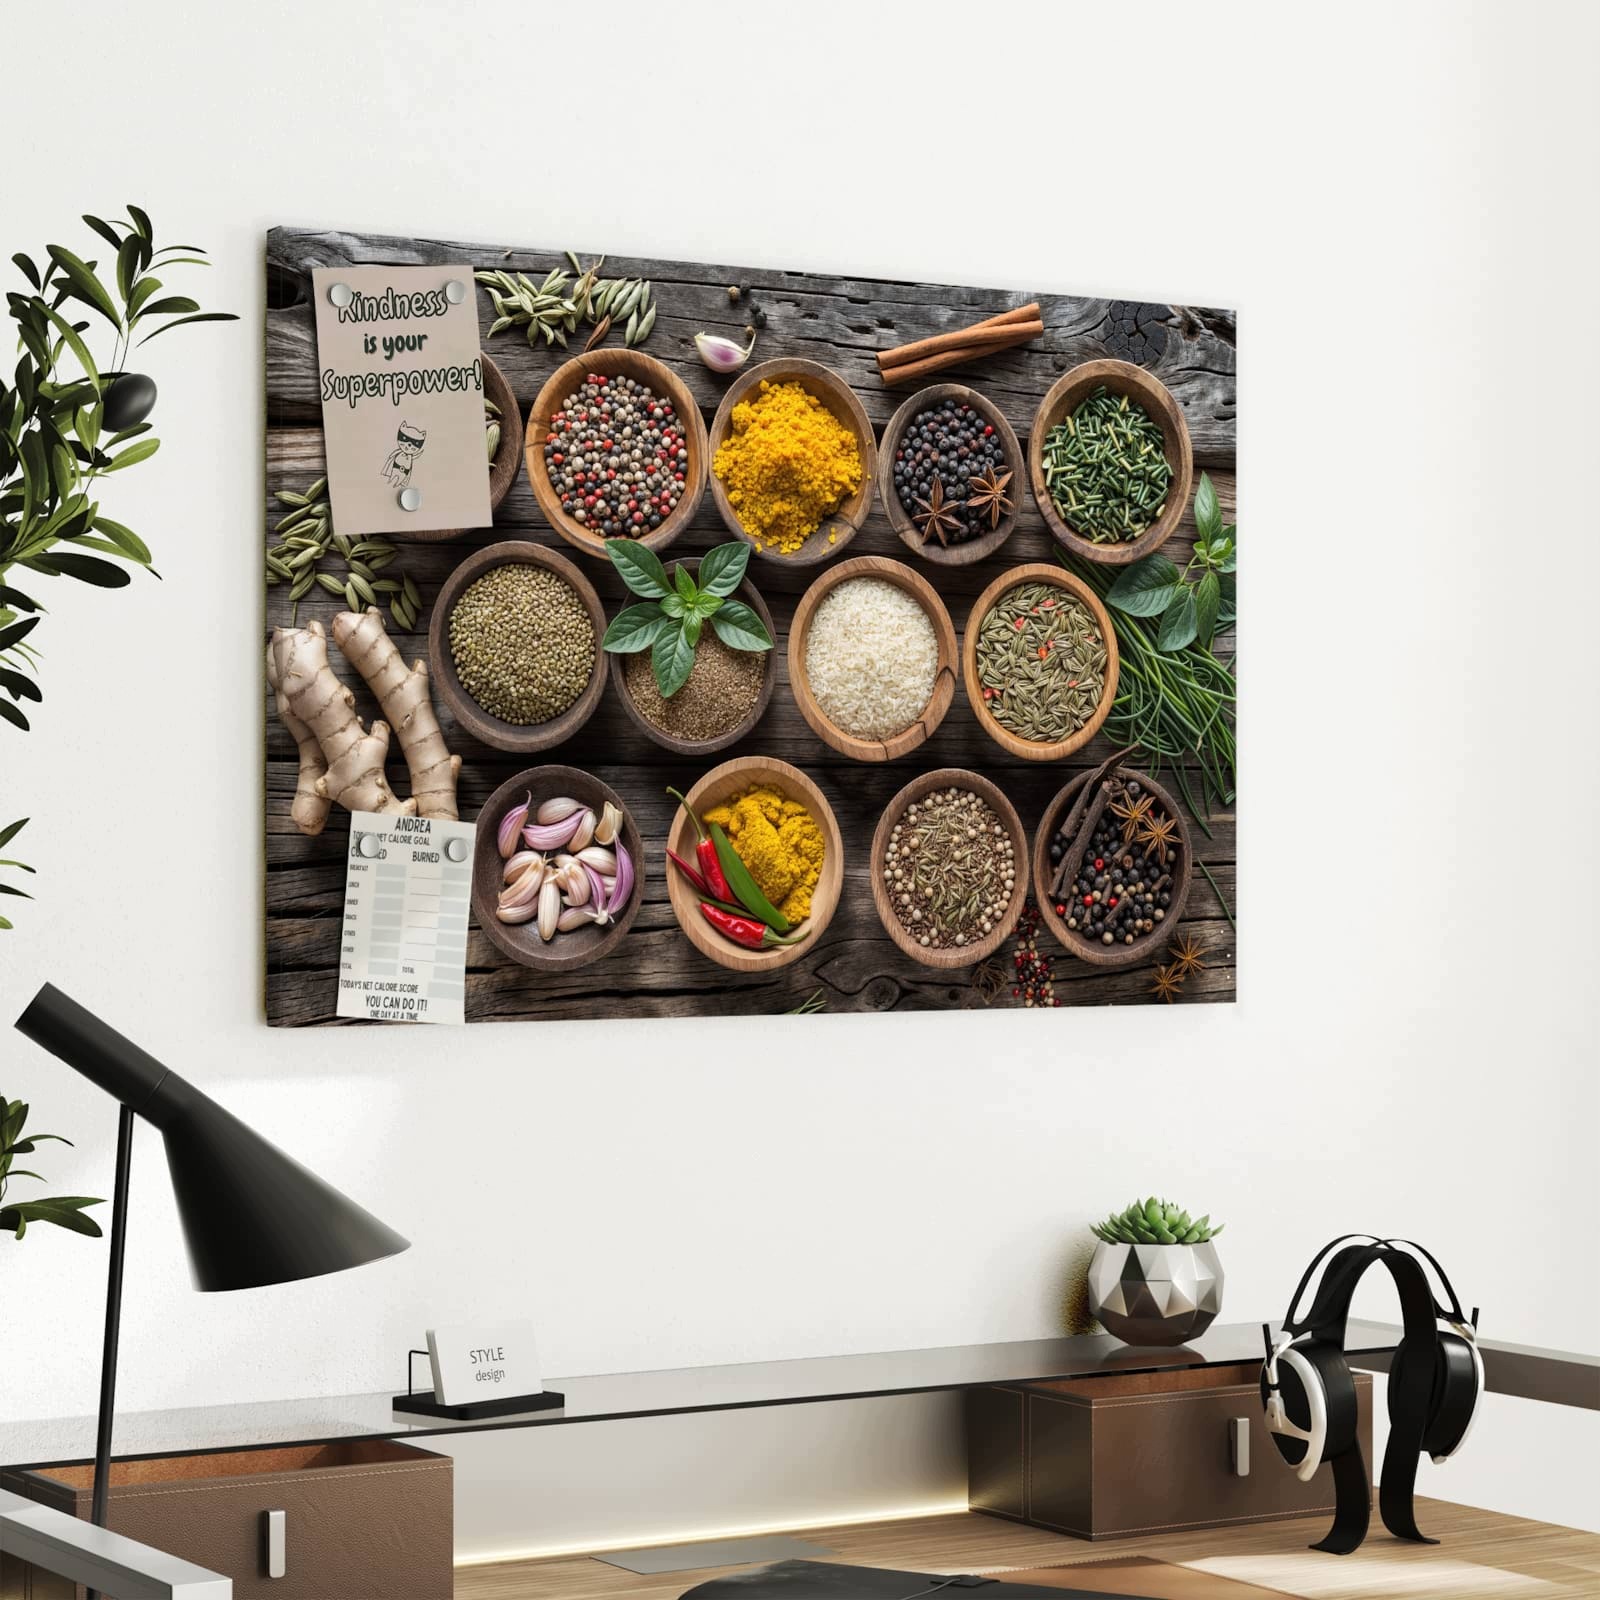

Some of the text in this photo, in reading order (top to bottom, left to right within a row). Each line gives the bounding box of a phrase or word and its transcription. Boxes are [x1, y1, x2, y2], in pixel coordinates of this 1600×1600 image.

[339, 287, 449, 323] Kindness
[363, 333, 428, 361] is your
[322, 359, 482, 408] Superpower!
[395, 817, 431, 833] ANDREA
[388, 834, 412, 845] CALORIE
[414, 836, 430, 846] GOAL
[412, 851, 440, 863] BURNED
[362, 980, 373, 990] NET
[374, 981, 398, 992] CALORIE
[399, 983, 419, 994] SCORE
[365, 994, 428, 1011] YOU CAN DO IT!
[370, 1009, 380, 1018] ONE
[380, 1010, 391, 1018] DAY
[392, 1011, 400, 1019] AT
[406, 1012, 419, 1021] TIME
[469, 1347, 505, 1364] STYLE
[475, 1368, 505, 1383] design
